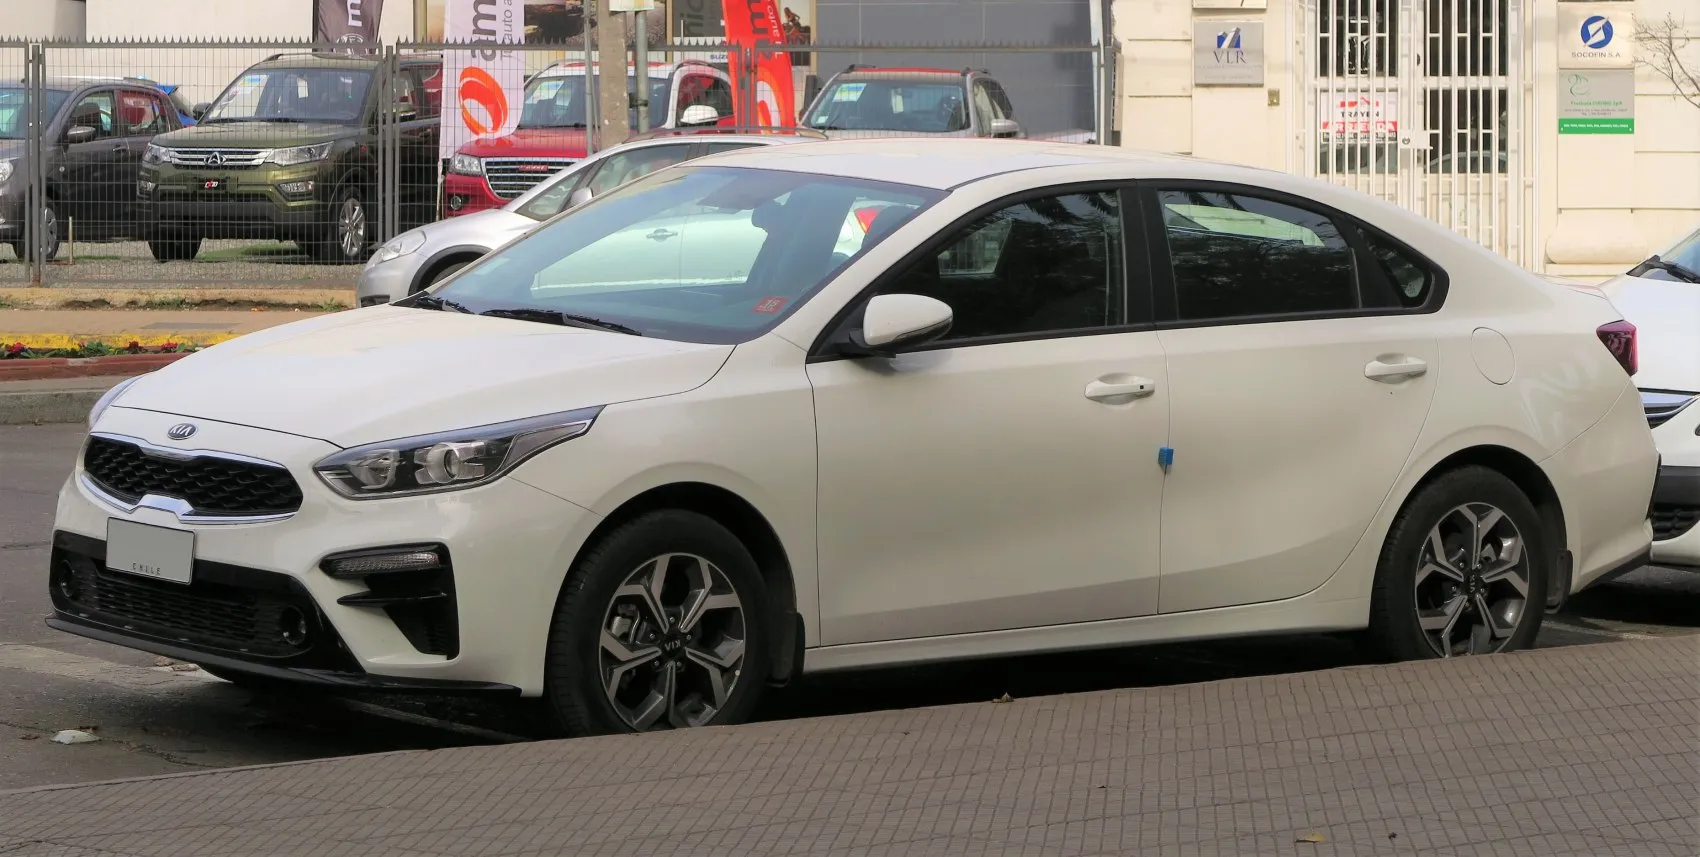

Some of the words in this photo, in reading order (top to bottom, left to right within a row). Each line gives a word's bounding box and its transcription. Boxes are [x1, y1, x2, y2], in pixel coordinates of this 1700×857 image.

[1213, 50, 1247, 64] VLR
[170, 424, 193, 436] KIA
[132, 562, 161, 575] CHILE
[665, 640, 680, 650] KIA
